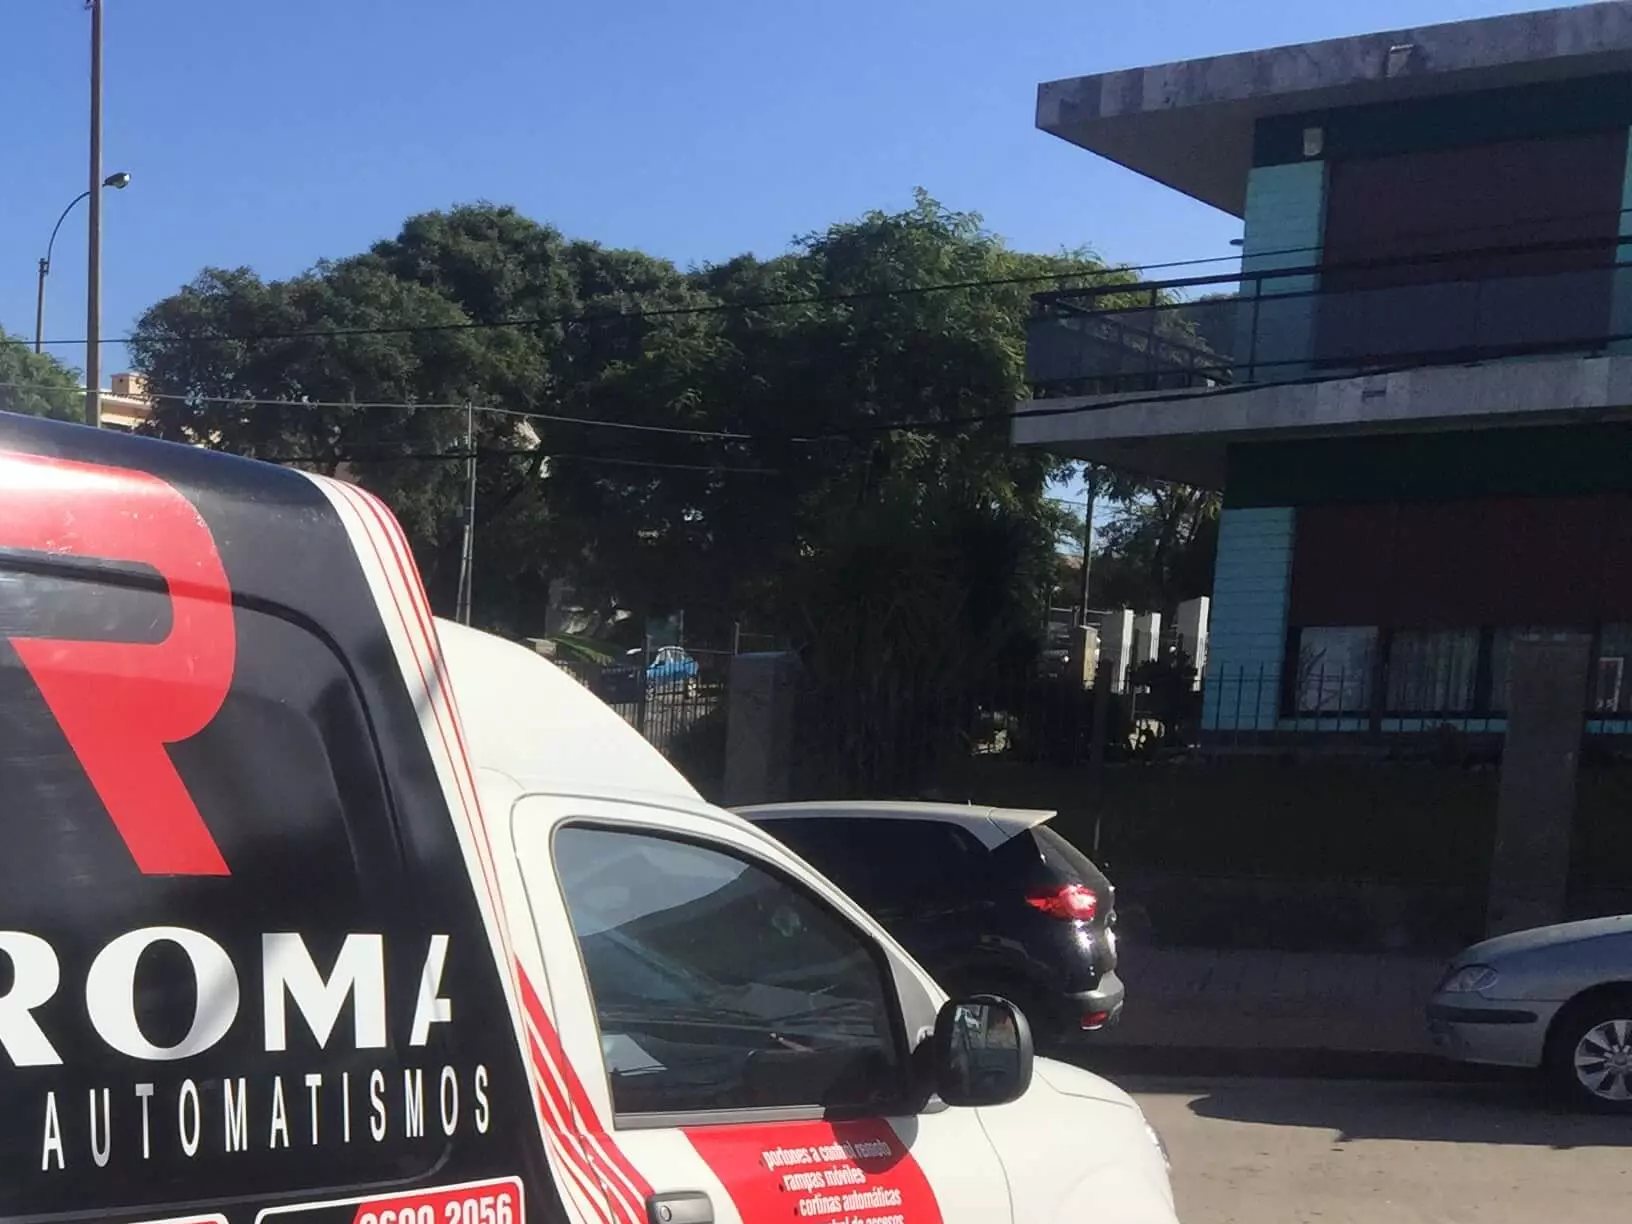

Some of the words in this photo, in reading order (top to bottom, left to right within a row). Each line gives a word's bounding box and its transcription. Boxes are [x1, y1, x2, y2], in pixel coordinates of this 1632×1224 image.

[41, 1063, 490, 1171] AUTOMATISMOS
[762, 1146, 812, 1171] portones
[809, 1147, 822, 1162] a
[782, 1171, 826, 1193] rampas
[799, 1192, 842, 1216] cortinas
[842, 1186, 902, 1211] automáticas
